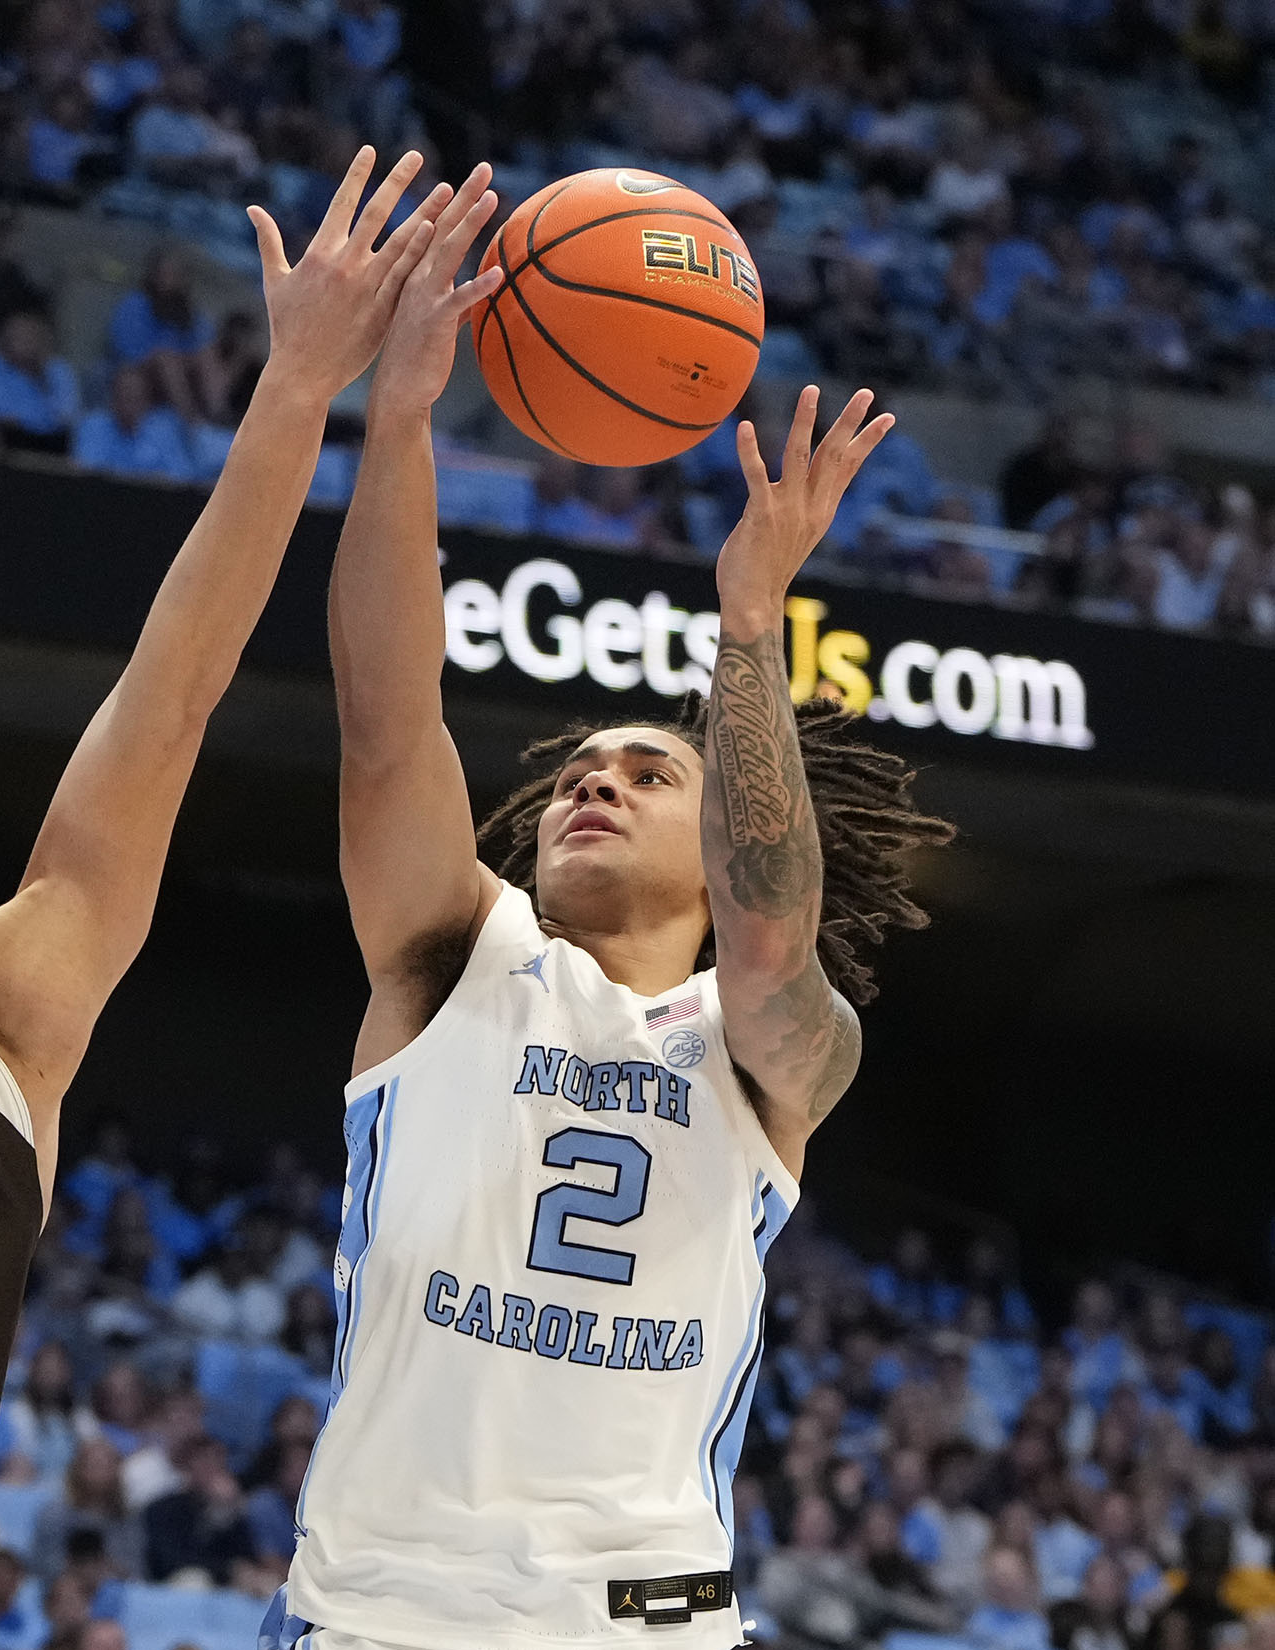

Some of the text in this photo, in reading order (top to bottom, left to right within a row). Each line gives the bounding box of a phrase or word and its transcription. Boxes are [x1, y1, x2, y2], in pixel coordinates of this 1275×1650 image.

[641, 229, 759, 304] ELITE
[439, 556, 1096, 750] eGetss.com
[513, 1045, 691, 1128] NORTH
[668, 1037, 702, 1056] ACC
[526, 1126, 652, 1286] 2
[424, 1270, 705, 1371] CAROLINA
[695, 1583, 716, 1600] 46
